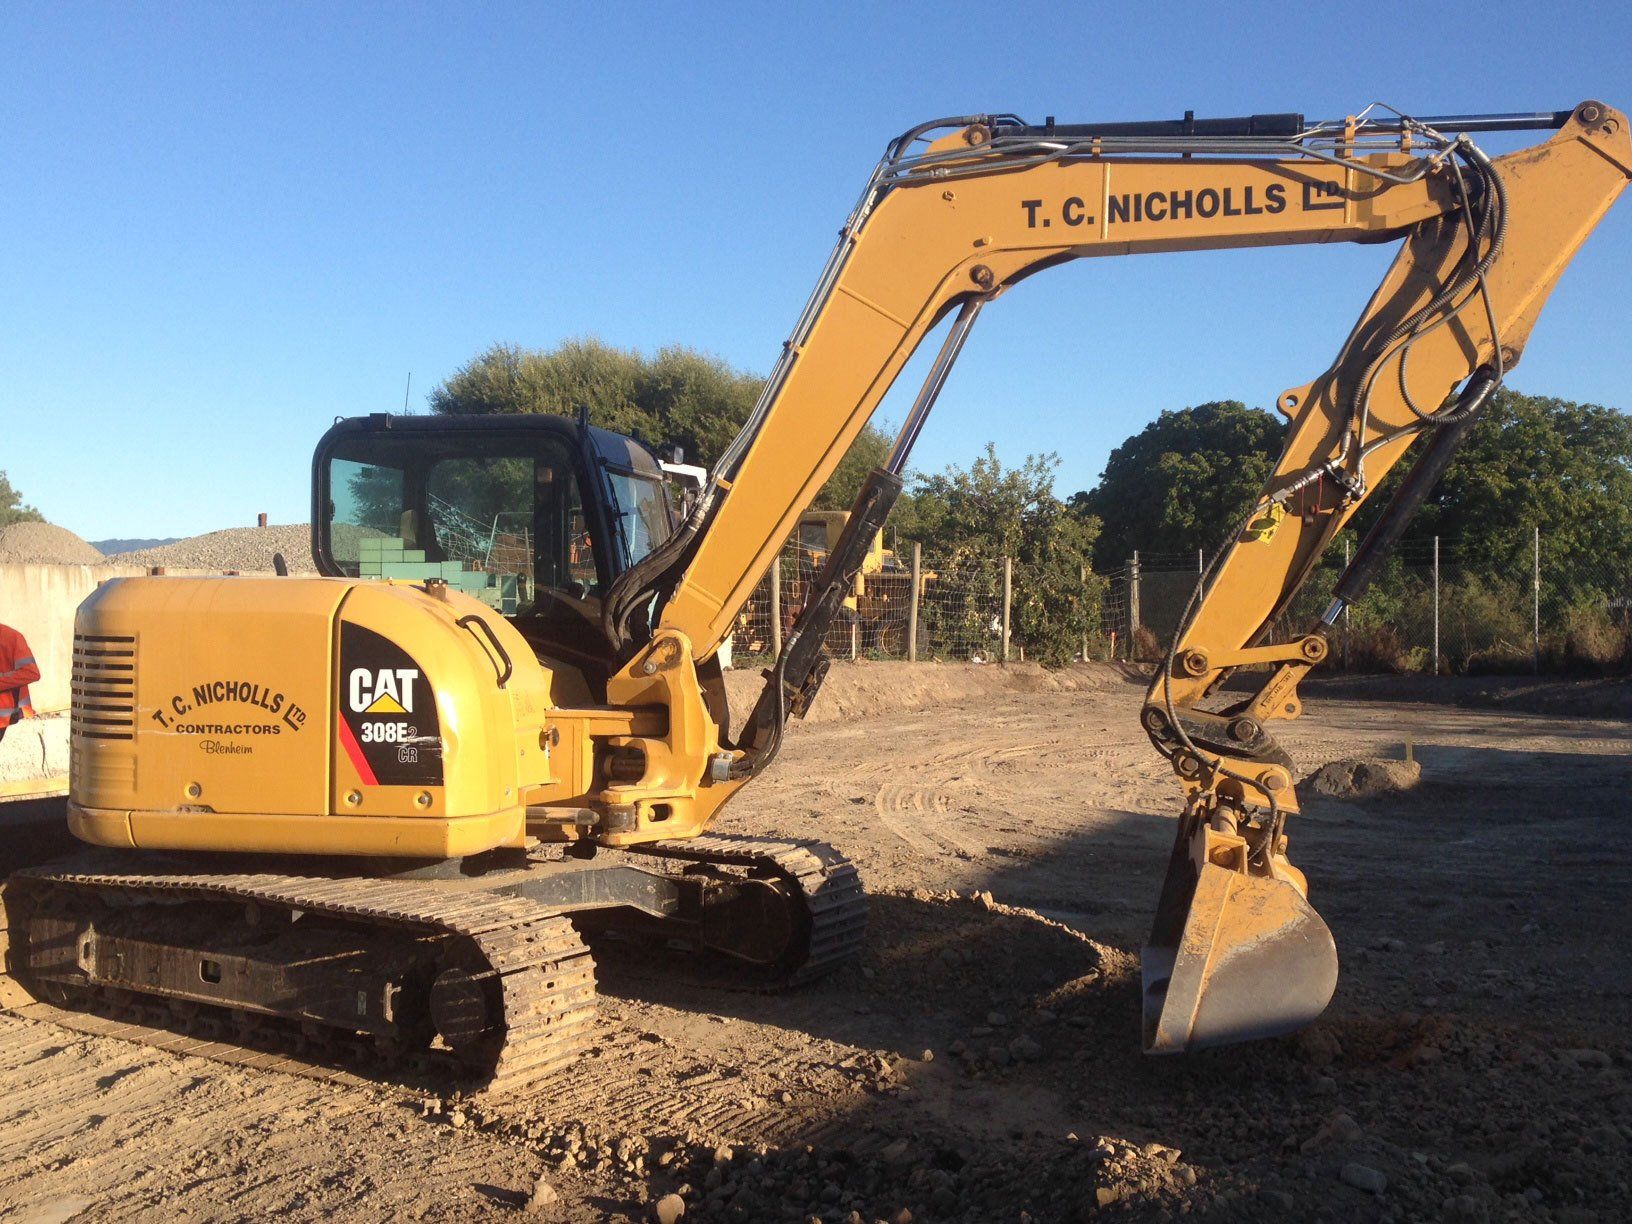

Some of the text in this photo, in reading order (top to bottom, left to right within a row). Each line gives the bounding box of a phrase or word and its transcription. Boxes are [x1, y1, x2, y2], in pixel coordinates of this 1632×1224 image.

[1022, 200, 1050, 228] T.
[1062, 196, 1095, 226] C.
[1108, 183, 1287, 223] NICHOLLS
[151, 709, 175, 728] T.
[171, 695, 192, 716] C.
[192, 681, 284, 714] NICHOLLS
[349, 667, 419, 713] CAT
[175, 724, 281, 735] CONTRACTORS
[199, 739, 253, 755] Blenheim
[397, 747, 418, 763] CR
